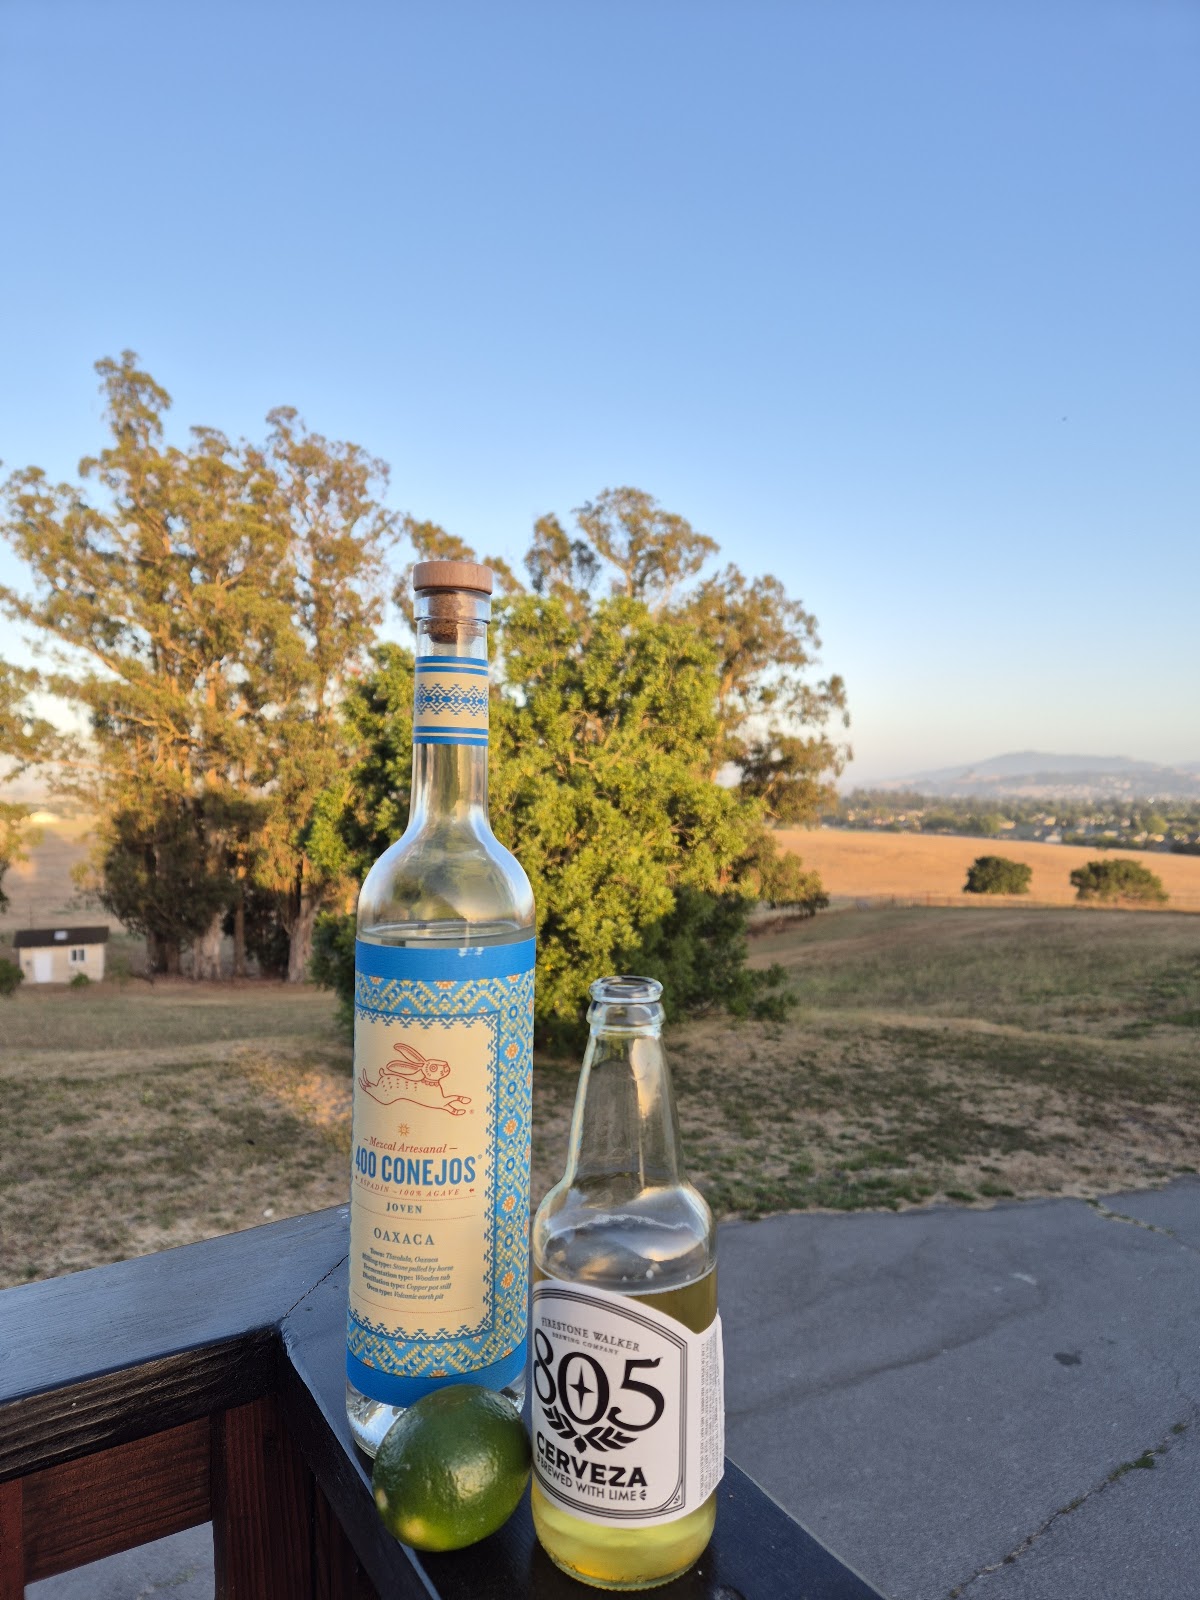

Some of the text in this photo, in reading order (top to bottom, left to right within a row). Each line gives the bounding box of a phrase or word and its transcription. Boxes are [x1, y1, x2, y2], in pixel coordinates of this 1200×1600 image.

[370, 1136, 448, 1154] Mezcal Artesanal
[355, 1145, 476, 1186] 400 CONEJOS
[426, 1188, 460, 1197] AGAVE
[386, 1202, 423, 1214] JOVEN
[373, 1227, 435, 1246] OAXACA
[541, 1317, 640, 1352] FIRESTONE WALKER
[582, 1341, 619, 1356] COMPANY
[533, 1327, 665, 1432] 805
[536, 1430, 648, 1487] CERVEZA
[540, 1458, 637, 1501] BREWED WITH LIME
